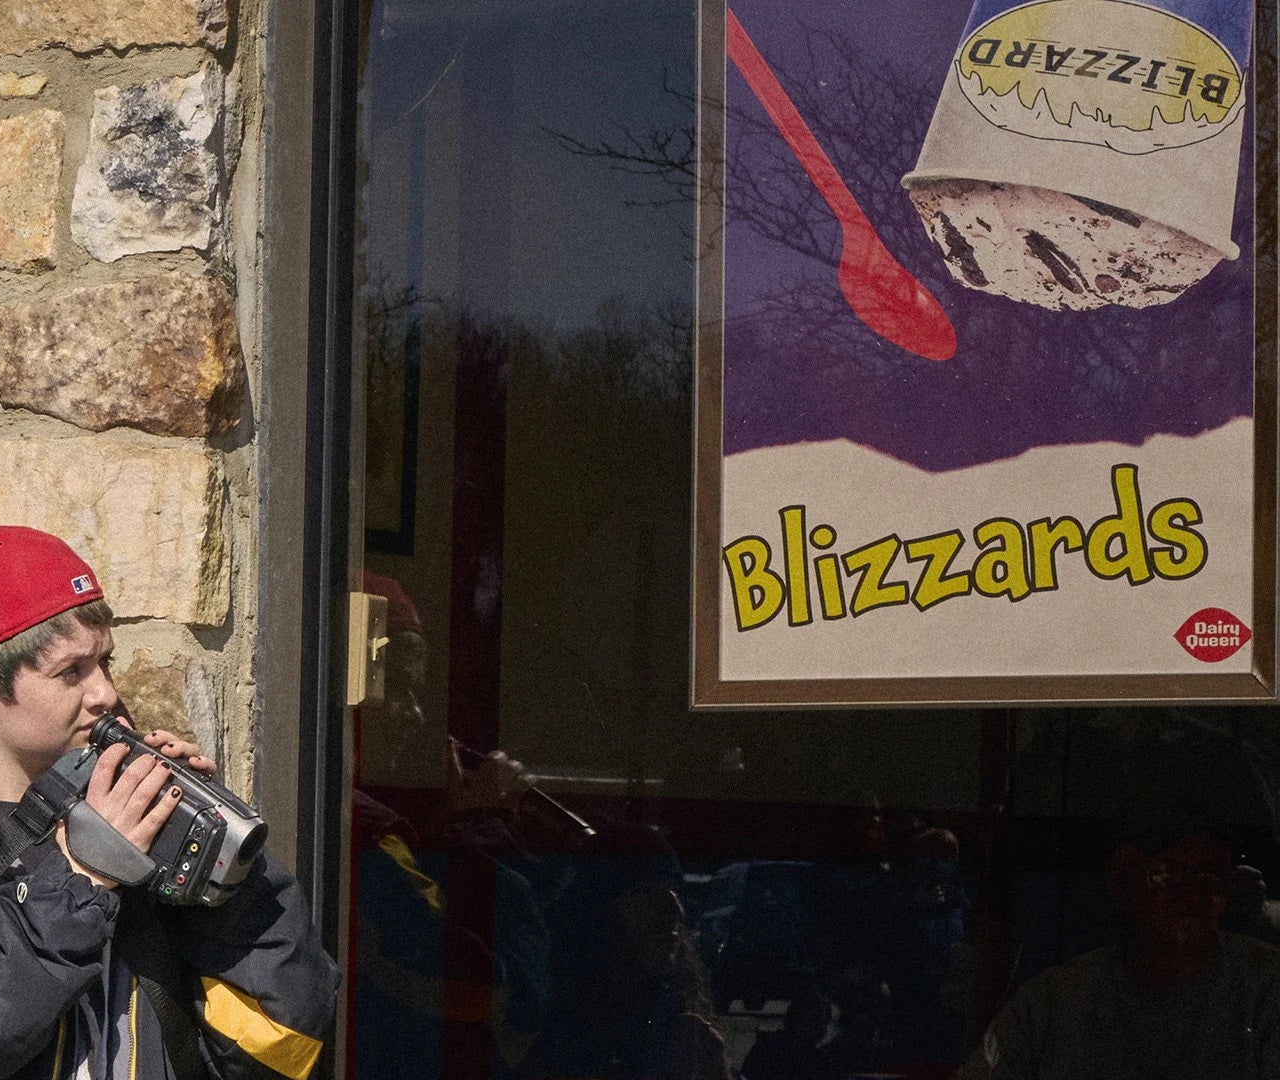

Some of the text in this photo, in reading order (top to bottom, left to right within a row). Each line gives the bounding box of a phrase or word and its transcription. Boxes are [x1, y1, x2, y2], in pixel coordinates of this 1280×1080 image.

[968, 38, 1231, 104] BLIZZARD
[723, 463, 1208, 632] Blizzards
[1186, 634, 1240, 650] Queen
[1194, 620, 1240, 636] Dairy
